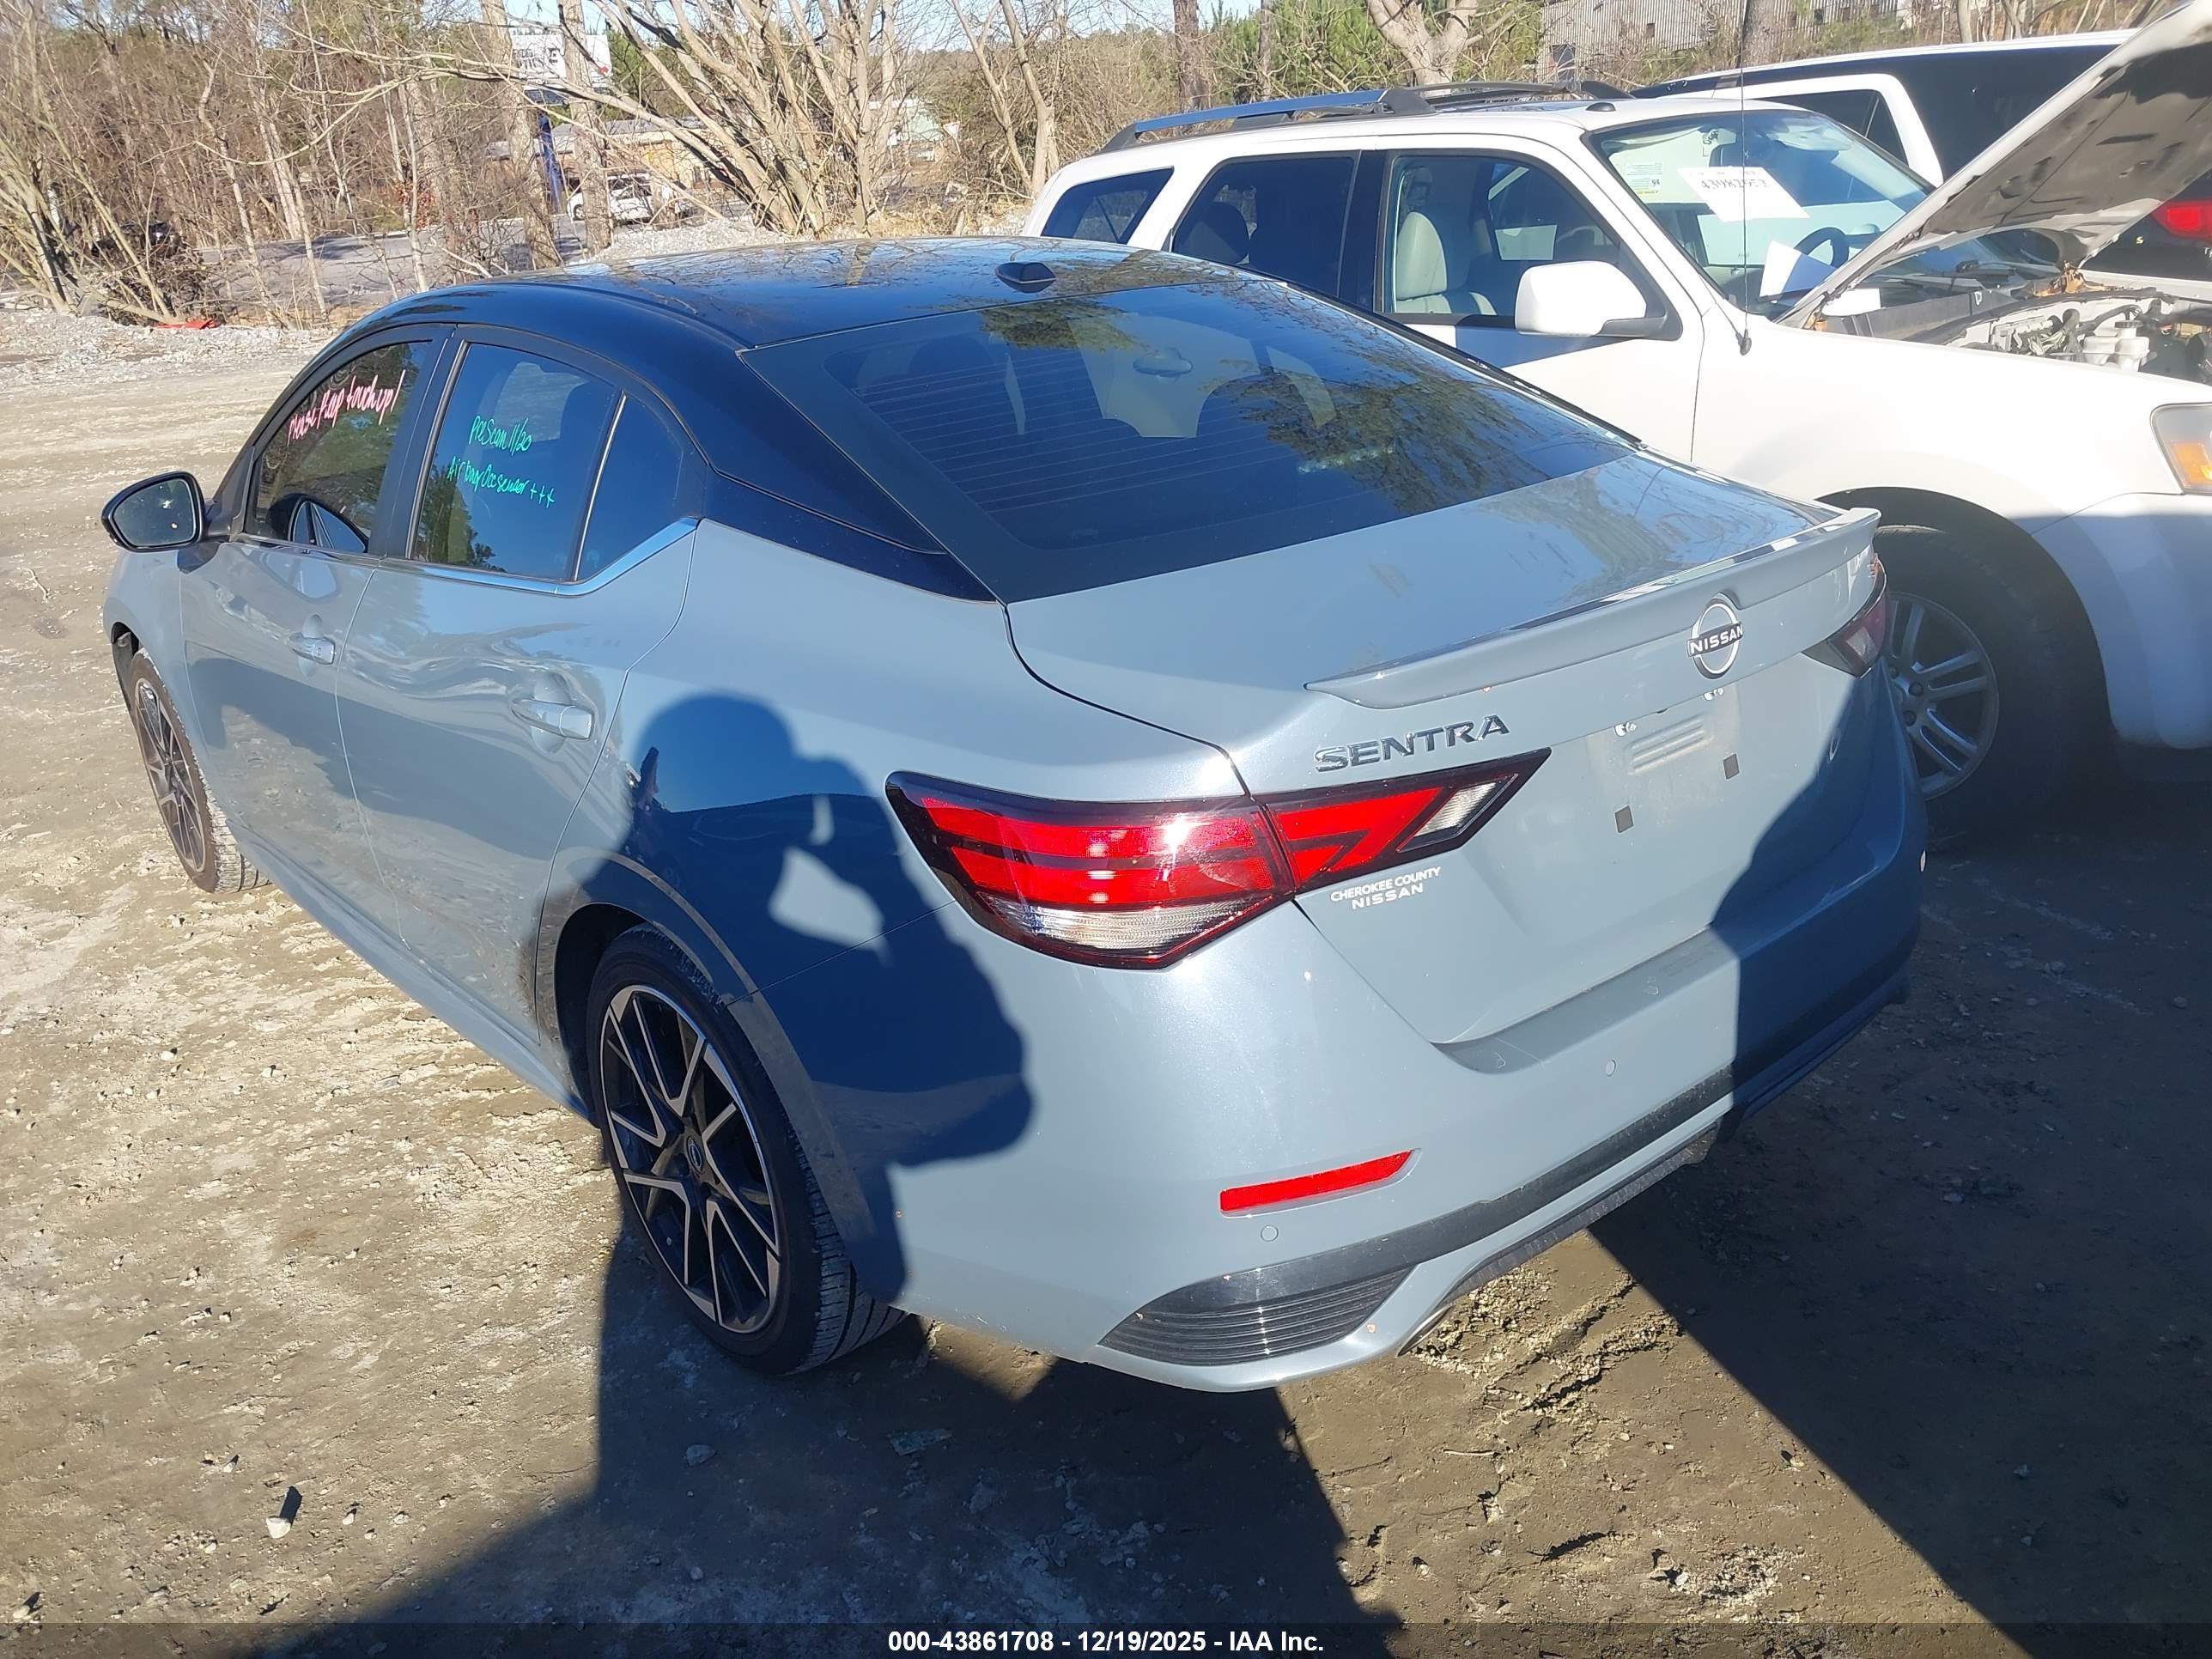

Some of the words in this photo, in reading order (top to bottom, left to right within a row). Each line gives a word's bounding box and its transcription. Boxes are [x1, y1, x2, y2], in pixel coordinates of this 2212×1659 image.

[1689, 623, 1744, 654] NISSAN
[1315, 714, 1510, 772] SENTRA
[1330, 877, 1393, 902] CHEROKEE
[1394, 866, 1442, 887] COUNTY
[1352, 883, 1424, 909] NISSAN
